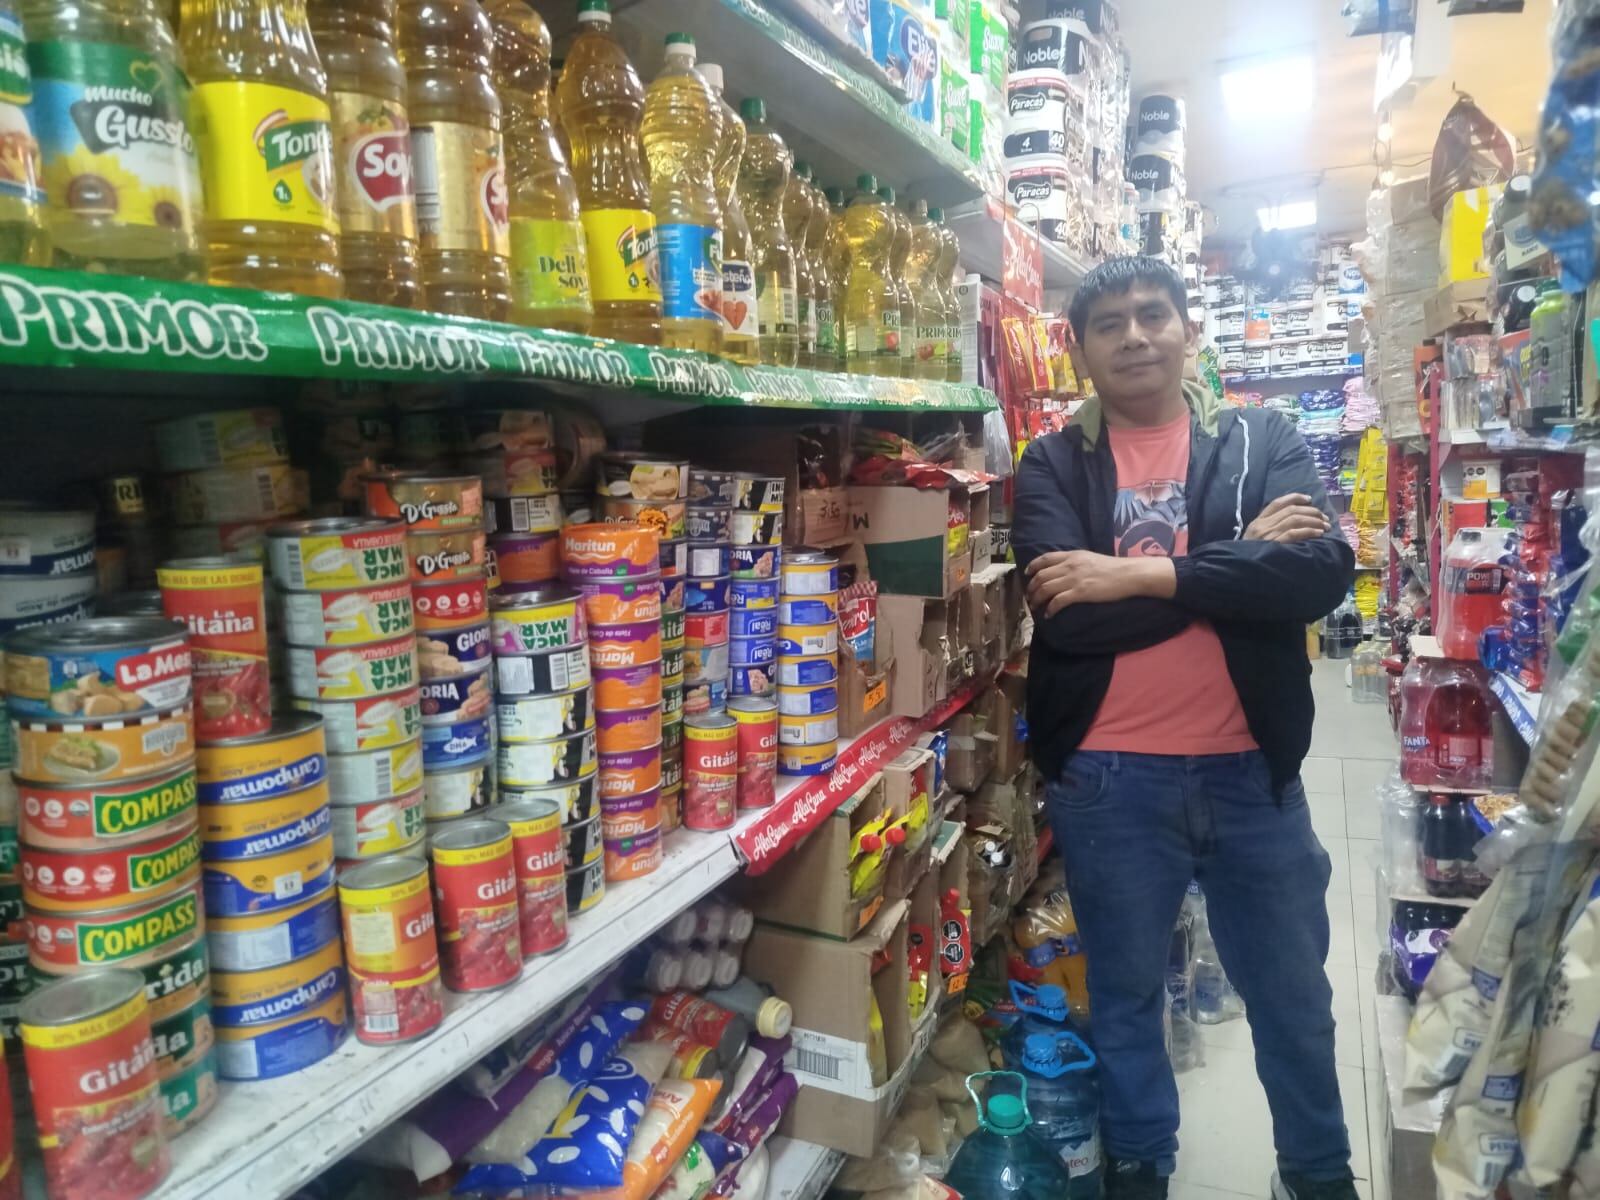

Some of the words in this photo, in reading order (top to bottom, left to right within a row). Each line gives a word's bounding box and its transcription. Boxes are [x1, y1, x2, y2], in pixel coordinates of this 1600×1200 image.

[1023, 47, 1064, 65] Noble
[1141, 111, 1170, 122] Noble
[1131, 169, 1159, 181] Noble
[540, 257, 576, 273] Deli
[0, 272, 268, 363] PRIMOR
[306, 306, 489, 372] PRIMOR
[514, 331, 635, 388] PRIMOR
[521, 618, 569, 637] MAR
[524, 633, 569, 650] INCA
[370, 653, 411, 676] MAR
[1404, 735, 1431, 747] FANTA
[220, 757, 319, 801] Campomar
[101, 774, 197, 834] COMPASS
[84, 898, 196, 962] COMPASS
[238, 970, 338, 1025] Campomar
